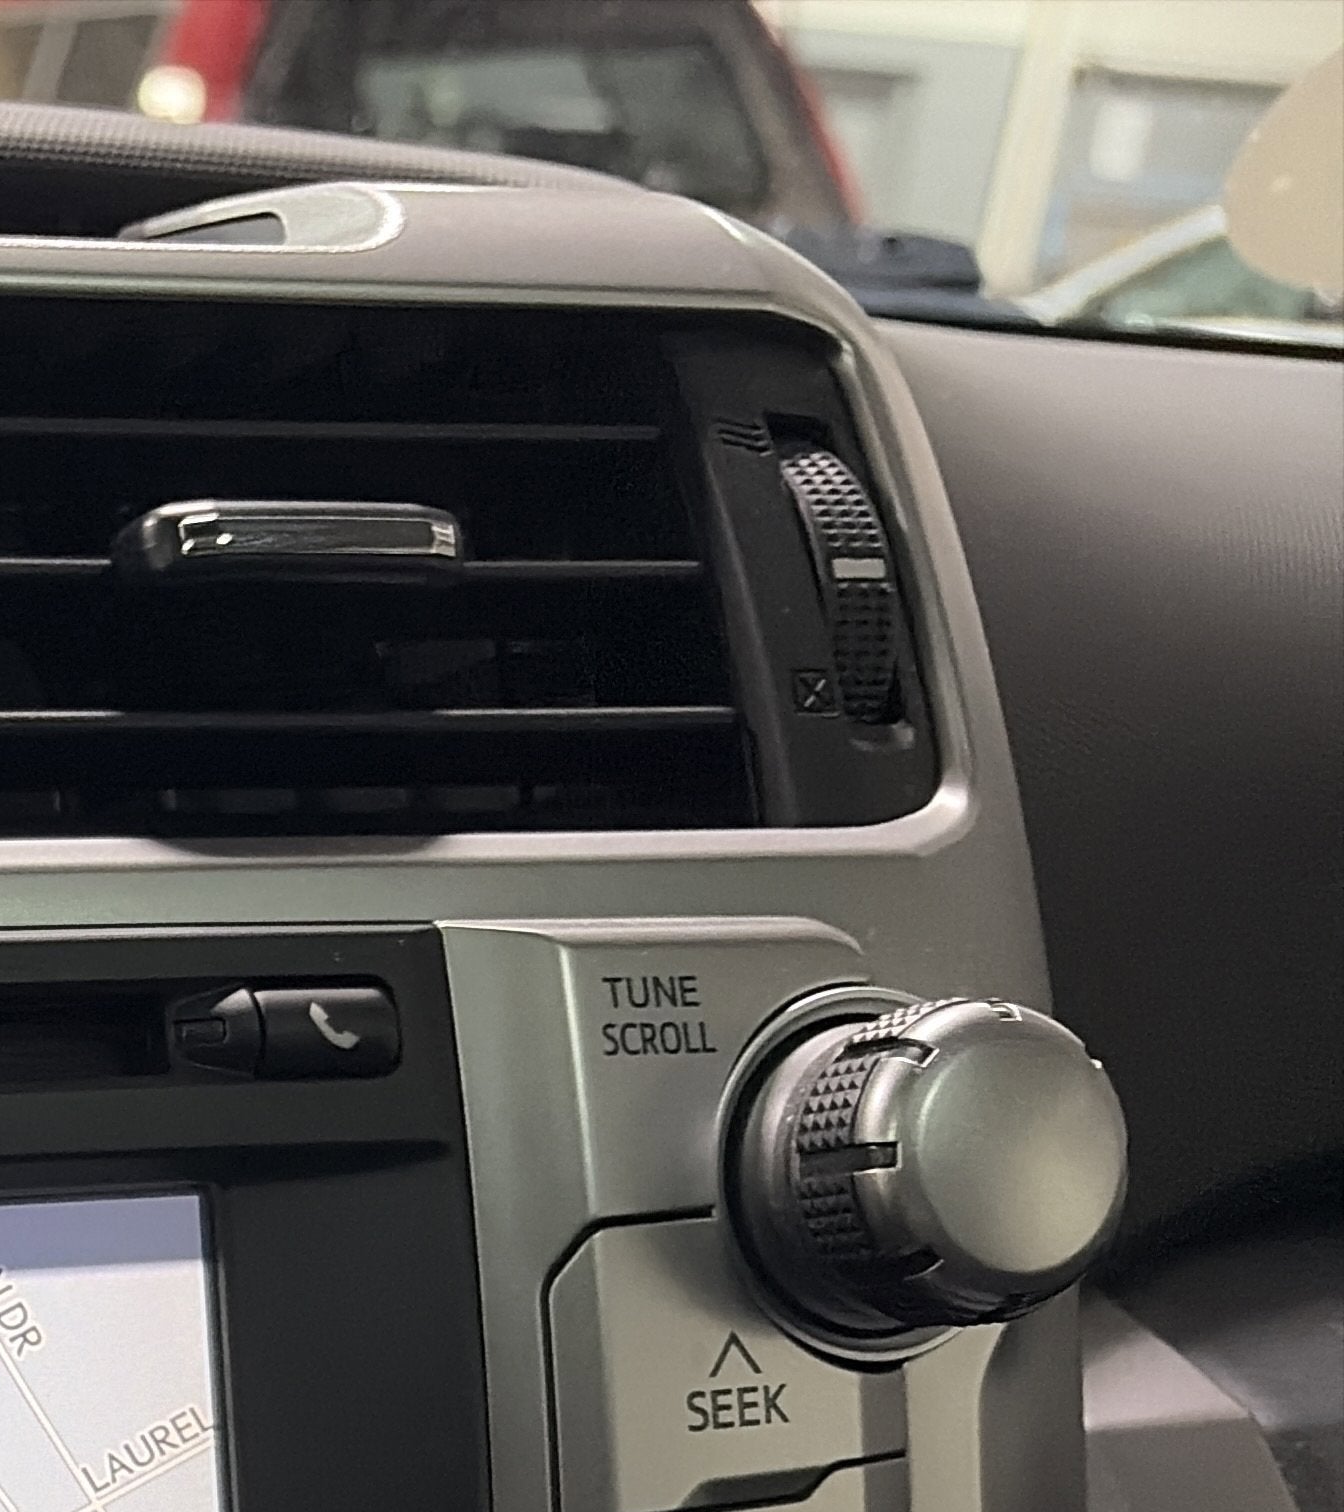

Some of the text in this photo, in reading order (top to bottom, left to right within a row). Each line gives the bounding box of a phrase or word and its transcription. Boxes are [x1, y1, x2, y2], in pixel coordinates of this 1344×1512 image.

[603, 977, 701, 1009] TUNE
[602, 1022, 717, 1056] SCROLL
[685, 1384, 790, 1432] SEEK
[81, 1407, 214, 1493] LAUREL
